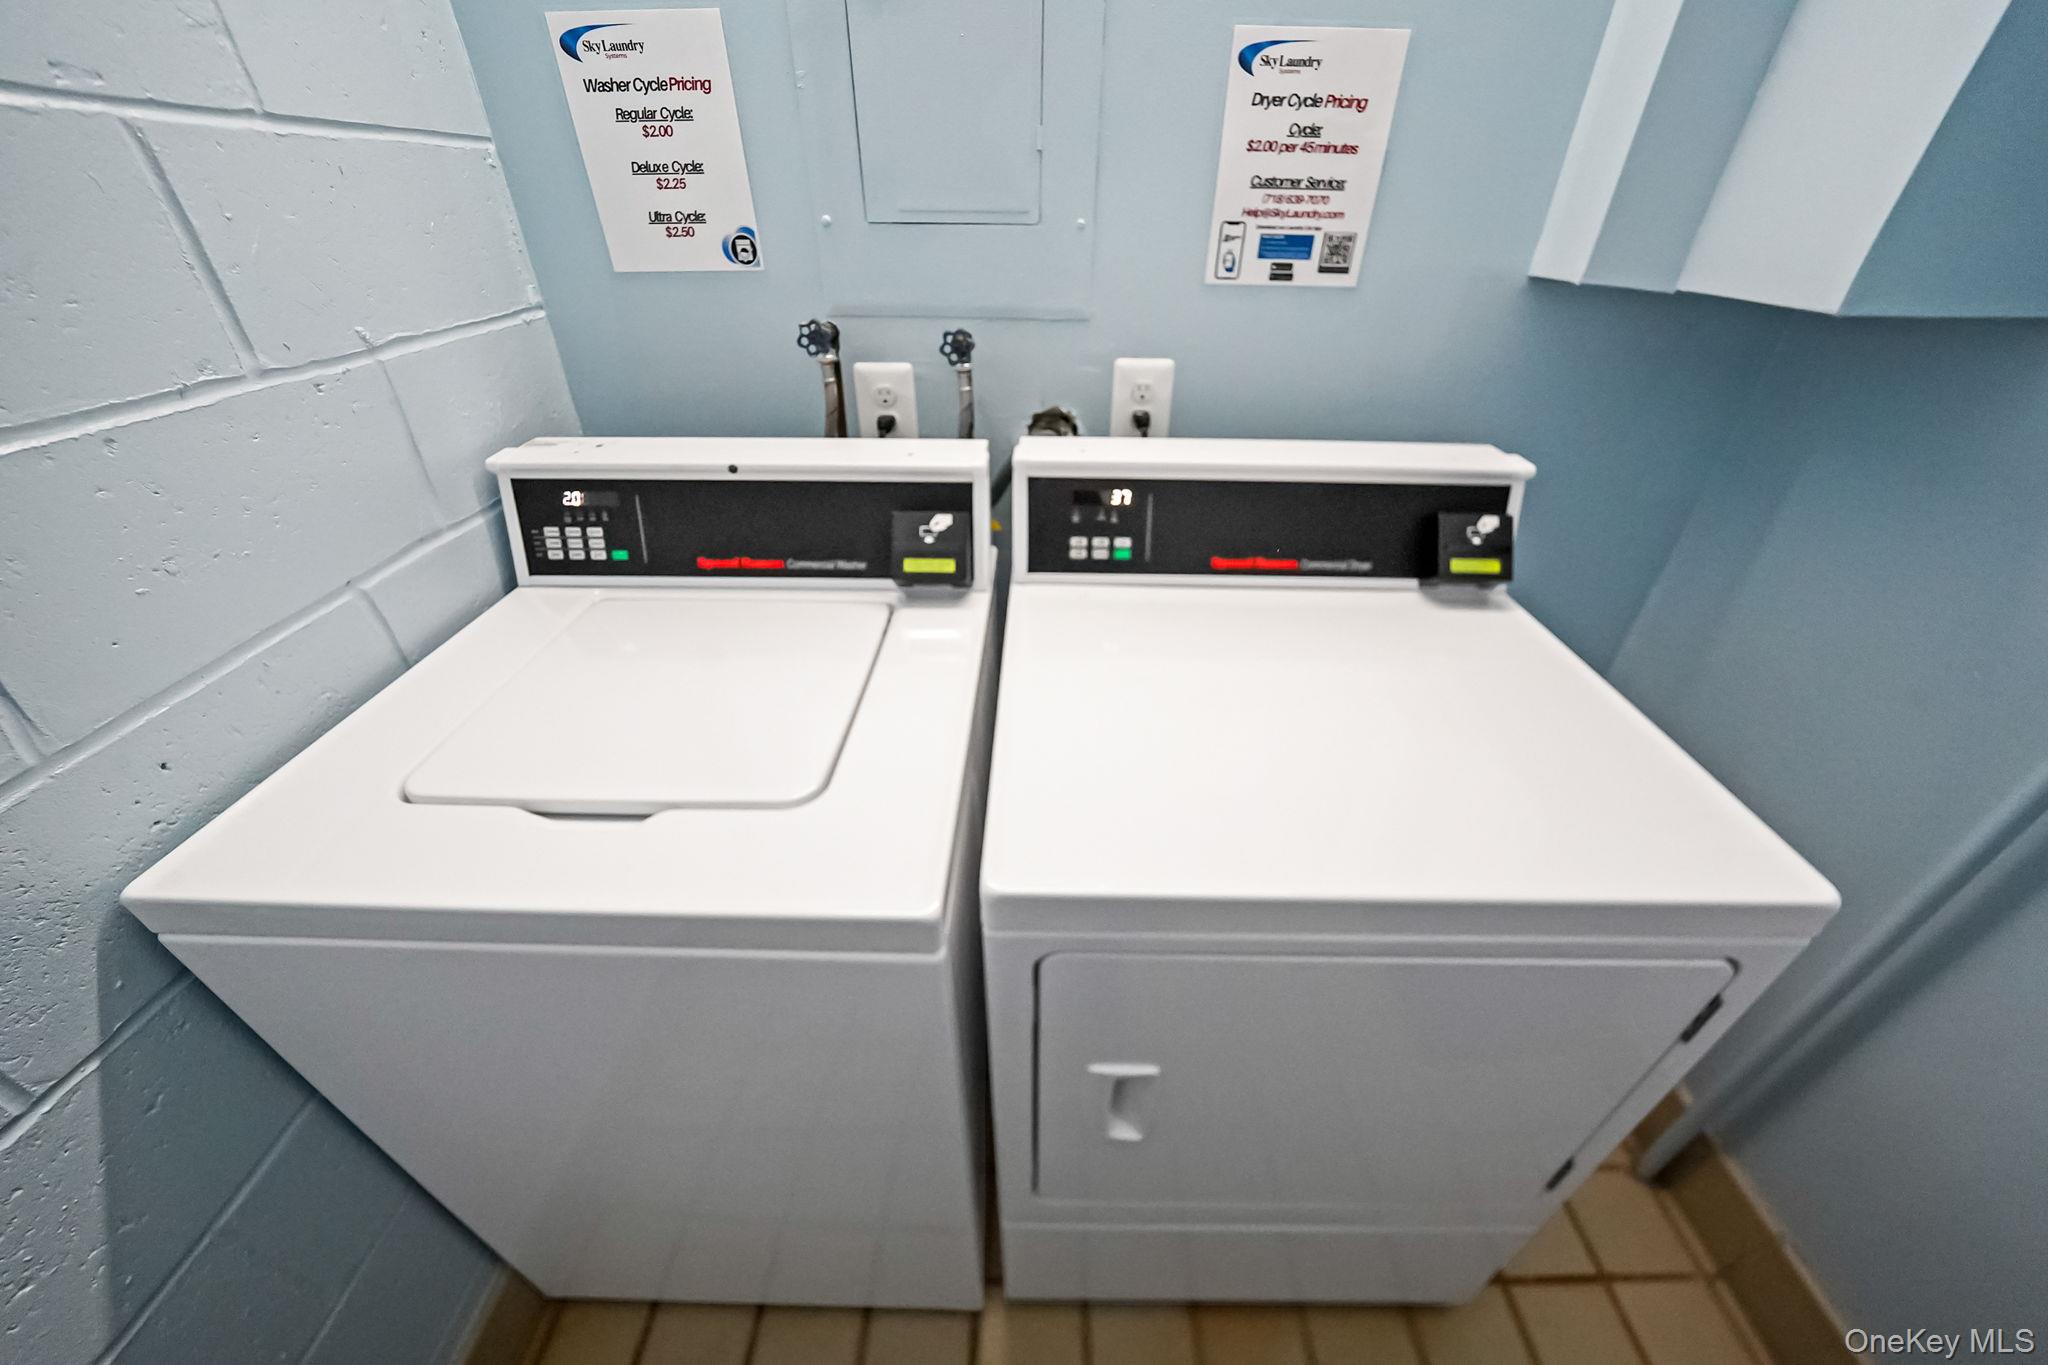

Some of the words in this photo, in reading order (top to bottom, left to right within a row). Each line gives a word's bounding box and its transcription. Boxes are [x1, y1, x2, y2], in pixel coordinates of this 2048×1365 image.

[582, 39, 601, 54] Sky
[603, 40, 644, 54] Laundry
[1259, 54, 1278, 69] Sky
[1280, 55, 1322, 70] Laundry
[583, 78, 630, 92] Washer
[632, 77, 668, 95] Cycle
[669, 76, 711, 94] Pricing
[1251, 92, 1286, 110] Dryer
[1288, 93, 1323, 110] Cycle
[1324, 94, 1369, 113] Pricing
[615, 107, 657, 122] Regular
[660, 106, 694, 121] Cycle:
[642, 125, 673, 138] $2.00
[1246, 140, 1278, 152] $2.00
[1278, 143, 1299, 155] per
[1300, 141, 1314, 153] 45
[1314, 141, 1359, 154] minutes
[631, 161, 669, 174] Deluxe
[671, 160, 704, 175] Cycle:
[656, 177, 686, 190] $2.25
[1250, 175, 1303, 189] Customer
[649, 211, 672, 224] Ultra
[674, 210, 706, 224] Cycle:
[665, 226, 695, 238] $2.50
